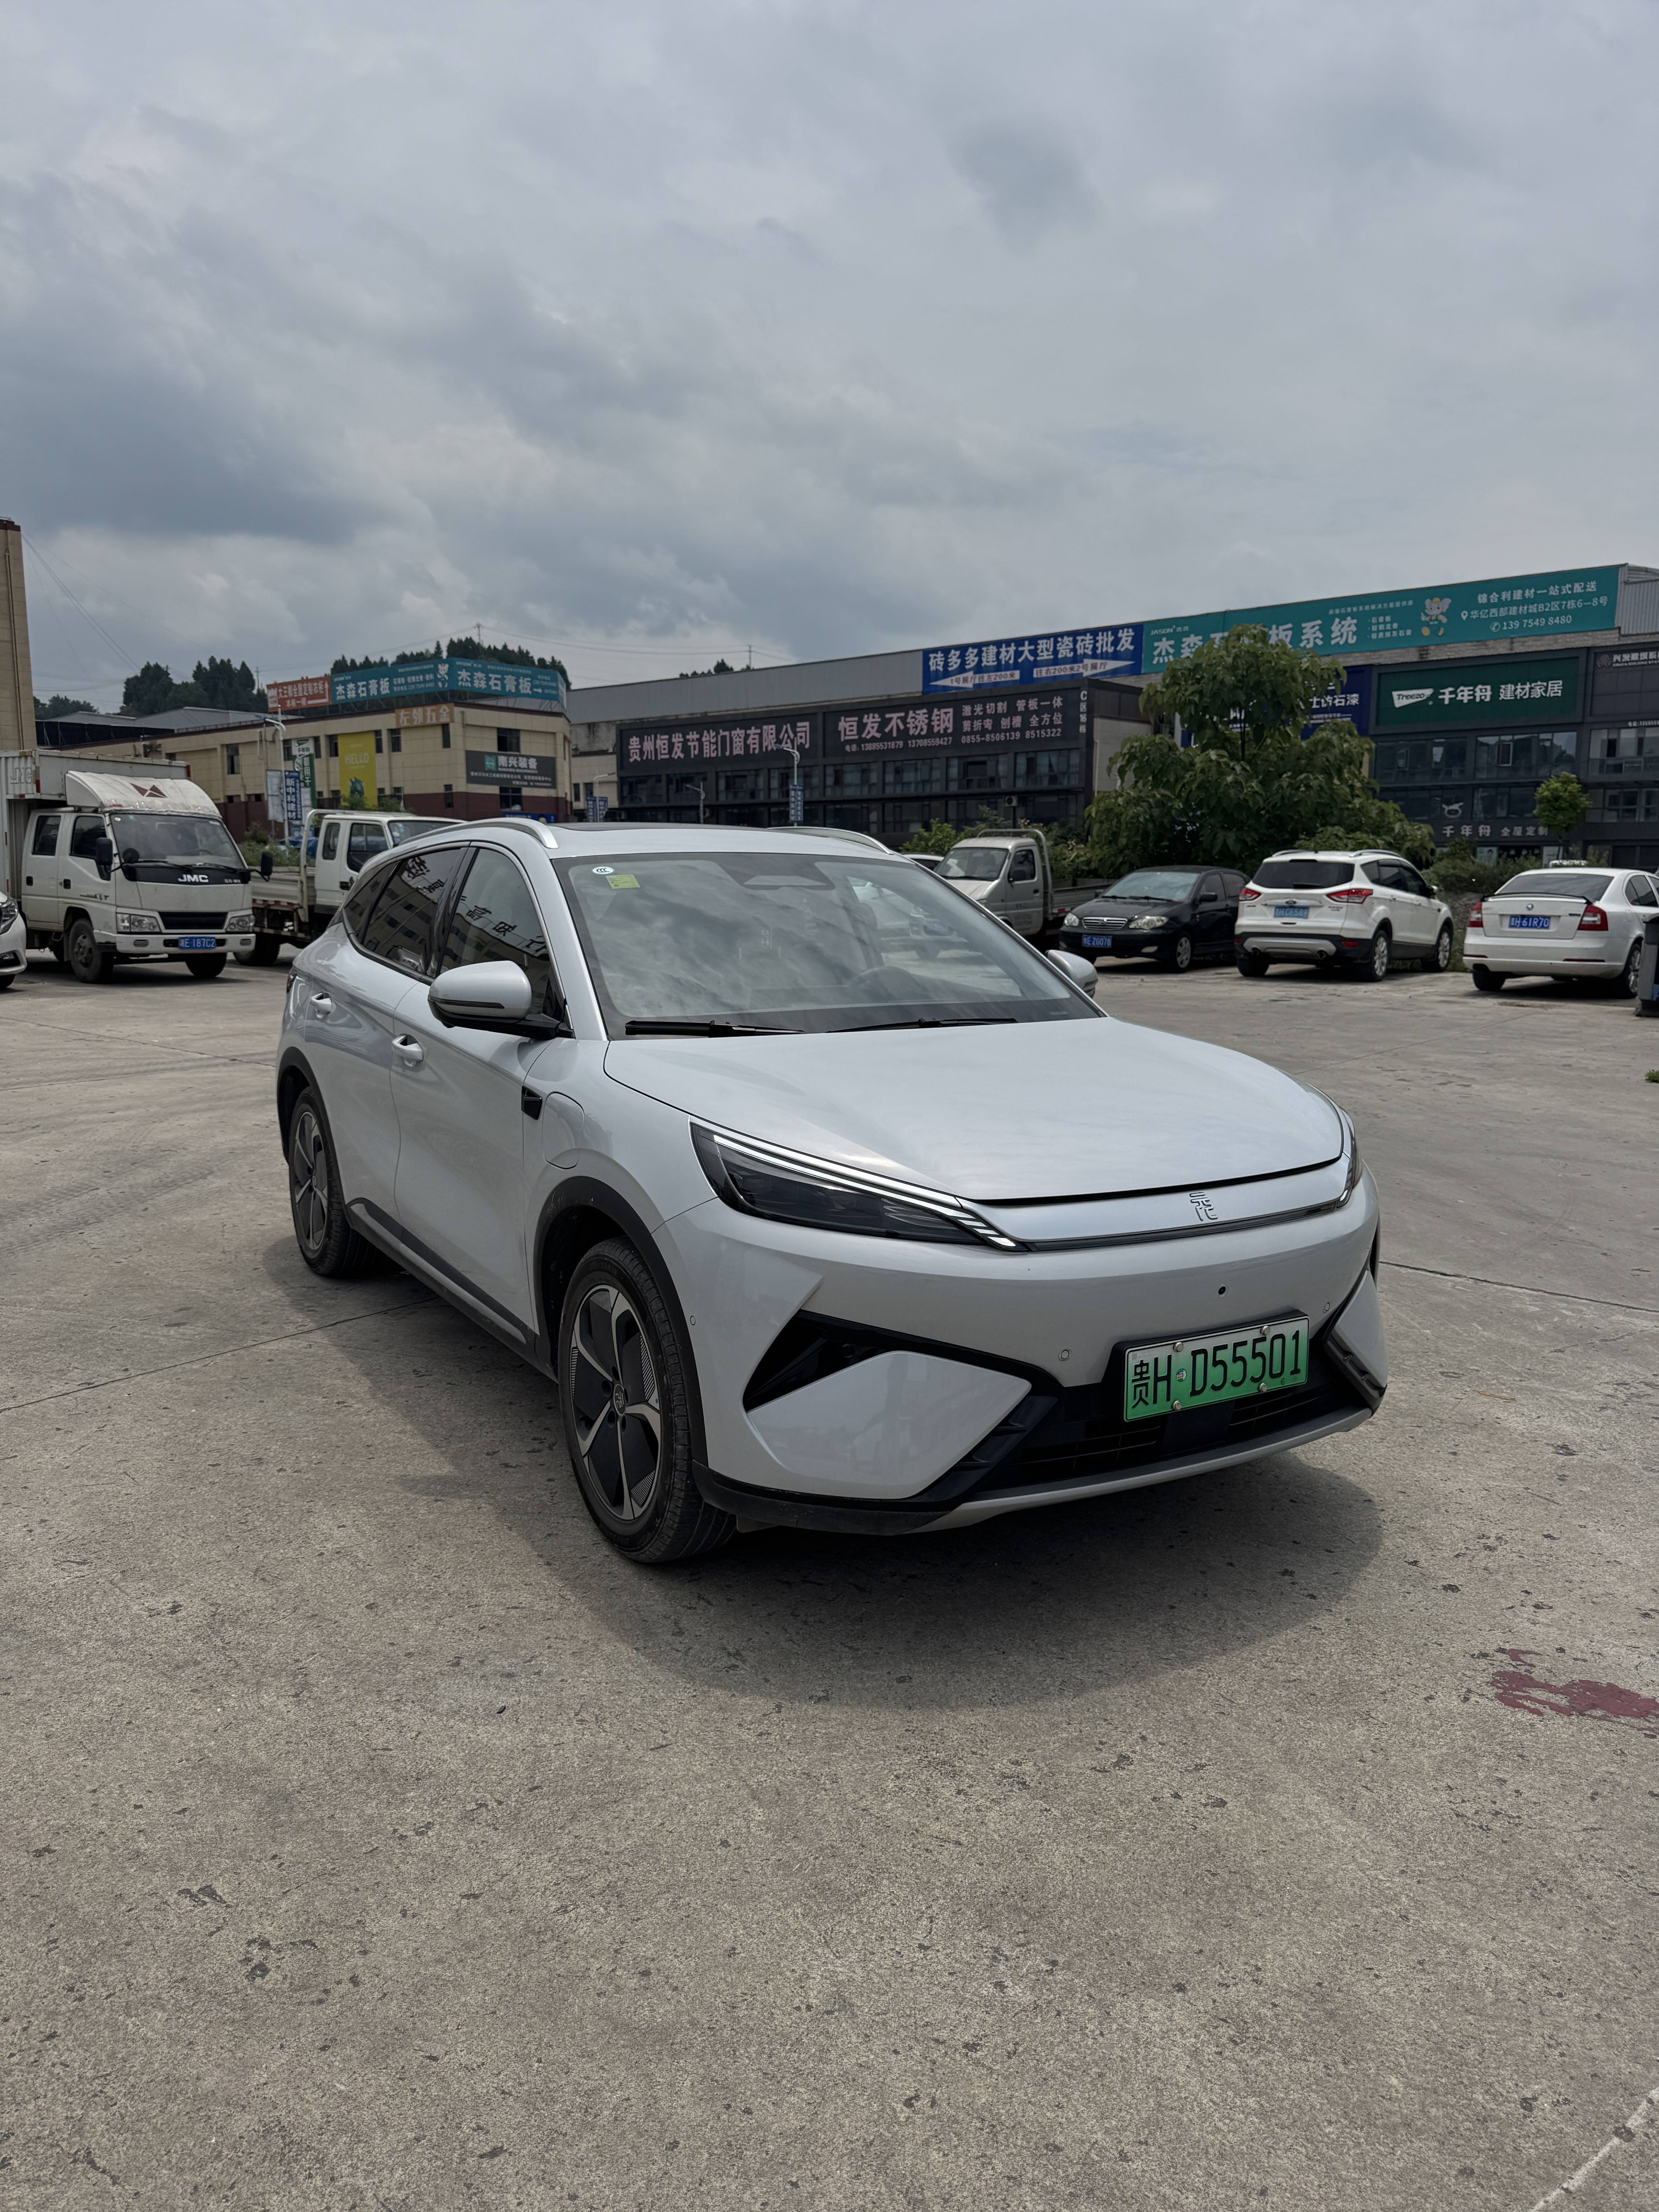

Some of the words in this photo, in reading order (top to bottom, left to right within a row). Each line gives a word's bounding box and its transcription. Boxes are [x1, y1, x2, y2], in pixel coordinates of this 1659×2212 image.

[929, 628, 1135, 672] 砖多多建材大型瓷砖批发
[1152, 616, 1357, 665] 杰森板系统
[336, 678, 390, 701] 杰森石膏板
[458, 669, 532, 694] 杰森石膏板
[1438, 684, 1492, 705] 千年舟
[1499, 680, 1563, 701] 建材家居
[962, 702, 1007, 716] 激光切割
[1016, 696, 1063, 712] 管板一体
[838, 708, 954, 742] 恒发不锈钢
[962, 718, 993, 732] 剪折弯
[1029, 712, 1063, 727] 全方位
[628, 721, 810, 763] 贵州恒发节能门窗有限公司
[498, 755, 538, 769] 南兴装备
[178, 874, 209, 883] JMC
